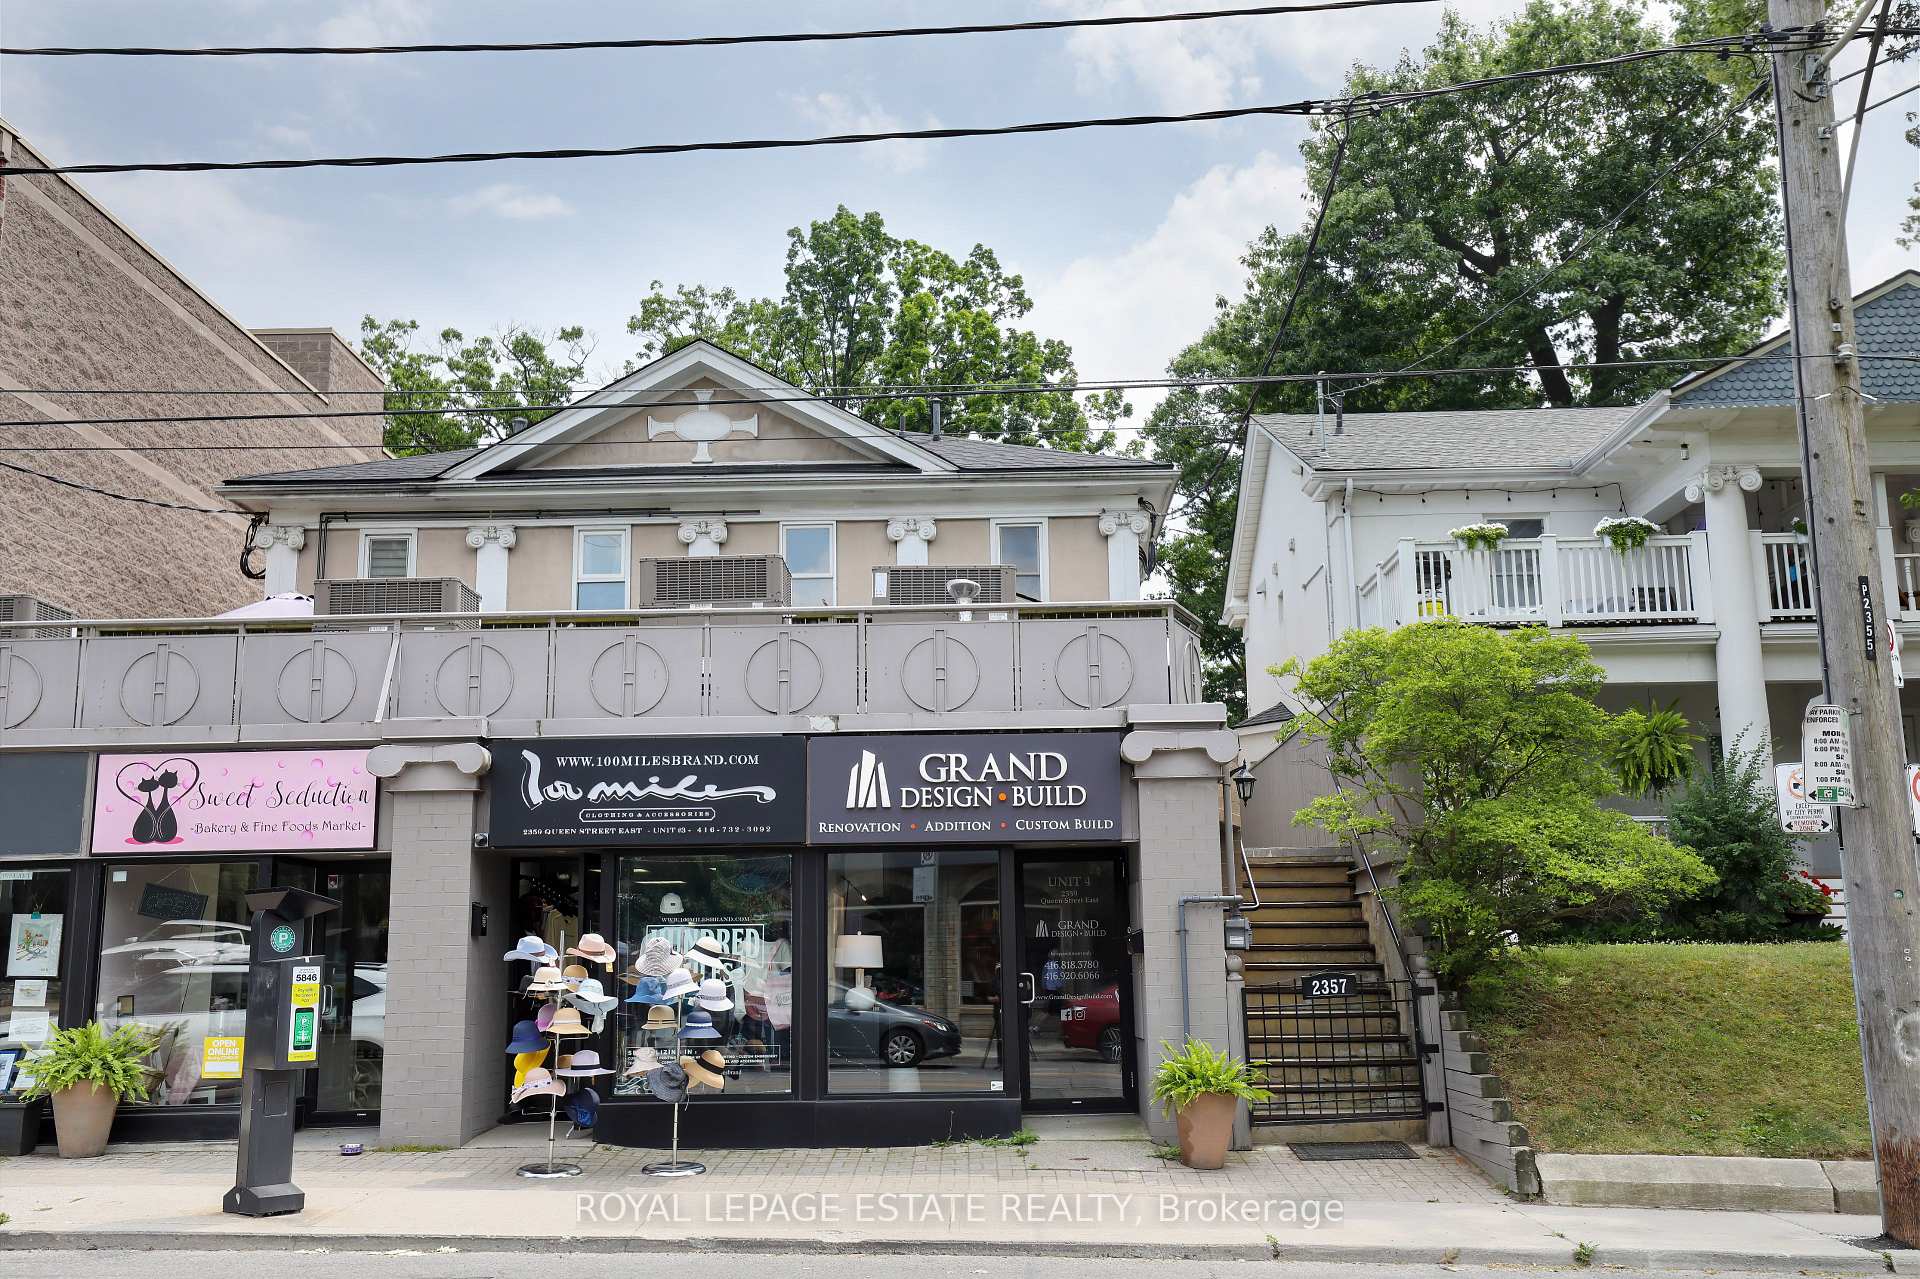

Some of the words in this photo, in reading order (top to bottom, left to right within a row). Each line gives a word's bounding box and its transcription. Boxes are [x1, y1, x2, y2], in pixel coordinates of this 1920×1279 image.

[1861, 584, 1873, 650] P2355
[556, 754, 760, 767] WWW.100MILESBRAND.COM
[919, 752, 1067, 784] GRAND
[188, 781, 257, 809] Sweet
[266, 780, 370, 809] Seduction
[900, 786, 994, 809] DESIGN
[1011, 784, 1088, 807] BUILD
[240, 822, 249, 832] &
[253, 821, 278, 832] Fine
[281, 820, 319, 832] Foods
[578, 827, 617, 835] STREET
[653, 826, 676, 834] UNIT
[819, 821, 902, 833] RENOVATION
[924, 820, 992, 832] ADDITION
[1015, 819, 1070, 831] CUSTOM
[1073, 818, 1114, 830] BUILD
[1047, 876, 1081, 887] UNIT
[1057, 919, 1099, 930] GRAND
[1051, 930, 1079, 938] DESIGN
[1085, 929, 1107, 937] BUILD
[295, 973, 318, 982] 5846
[1312, 978, 1347, 995] 2357
[212, 1039, 237, 1048] OPEN
[207, 1047, 241, 1056] ONLINE
